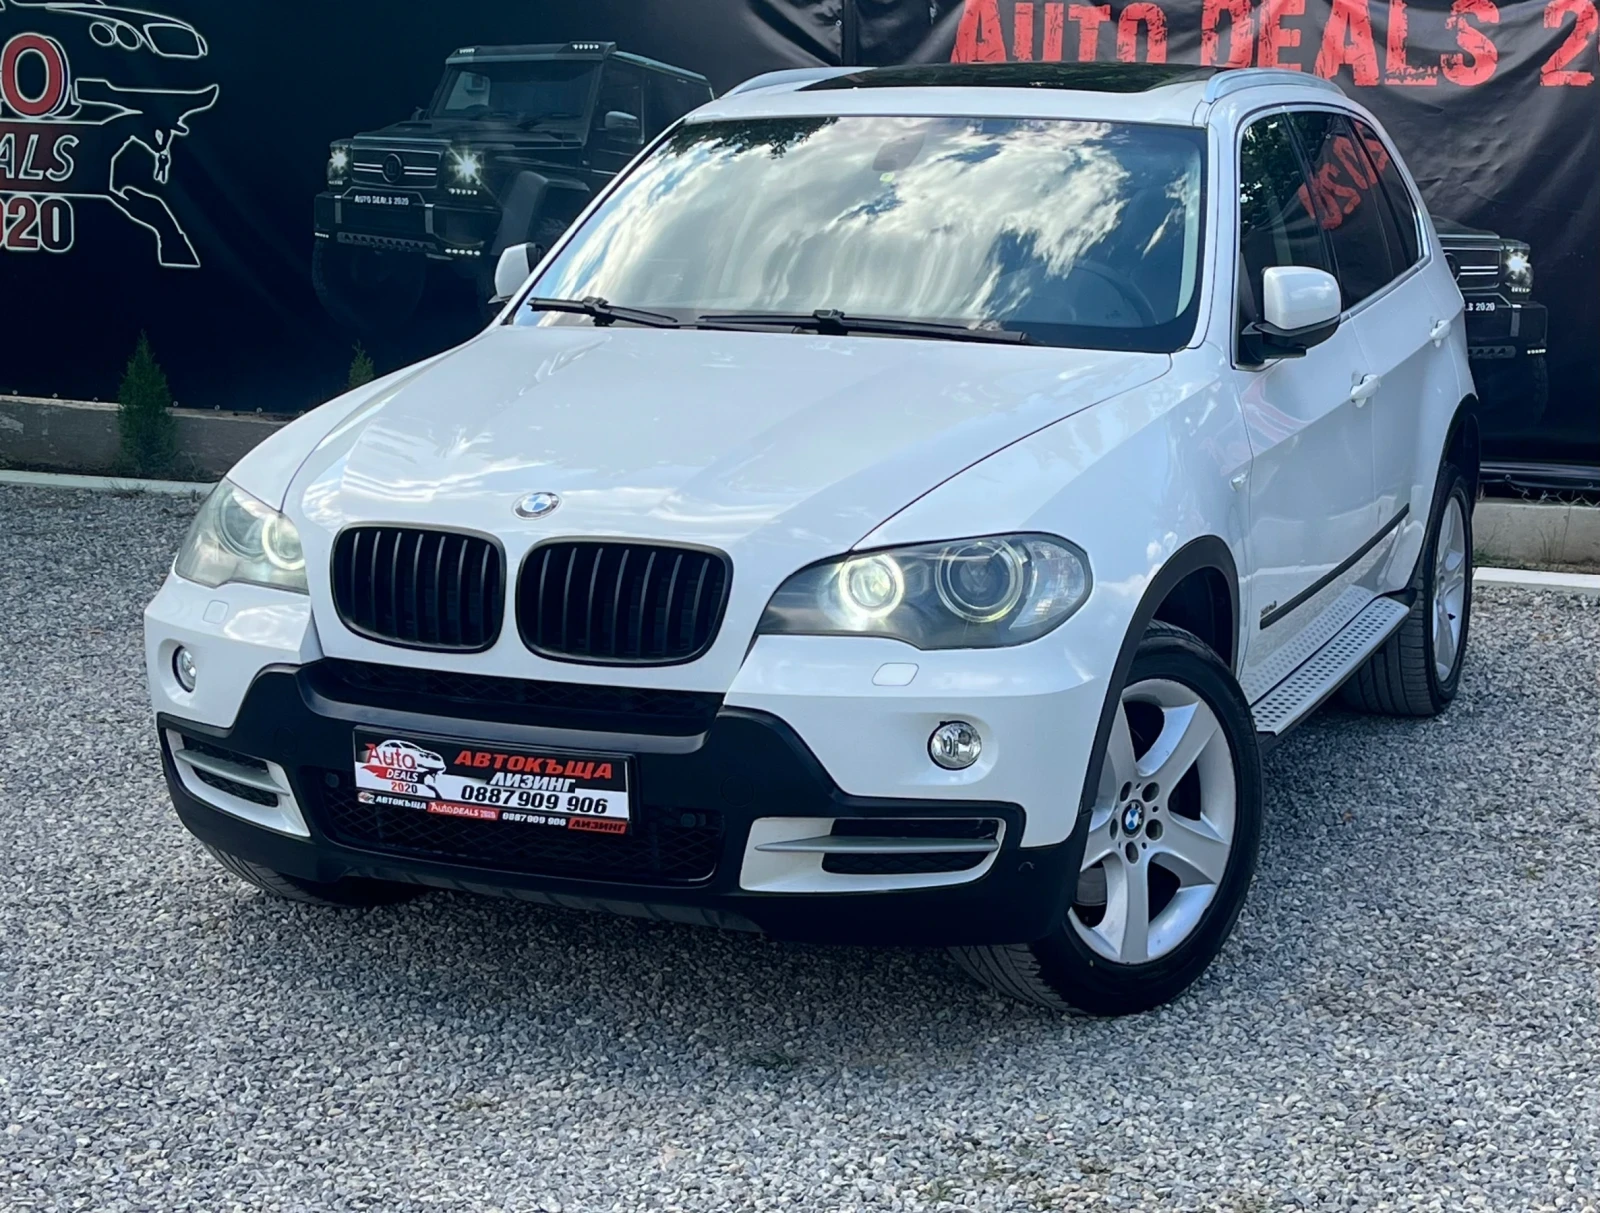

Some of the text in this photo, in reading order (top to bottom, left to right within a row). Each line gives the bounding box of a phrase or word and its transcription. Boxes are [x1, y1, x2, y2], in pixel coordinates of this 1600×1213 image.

[1201, 0, 1500, 87] DEALS
[1540, 0, 1600, 87] 2
[0, 32, 70, 119] O
[354, 195, 371, 203] AUTO
[0, 194, 75, 253] 20
[1475, 302, 1495, 311] 2020
[365, 743, 418, 770] Auto
[453, 750, 613, 779] АВТОКЪЩА
[385, 769, 419, 782] DEALS
[391, 781, 419, 794] 2020
[489, 771, 576, 793] ЛИЗИНГ
[461, 784, 609, 815] 0887 909 906
